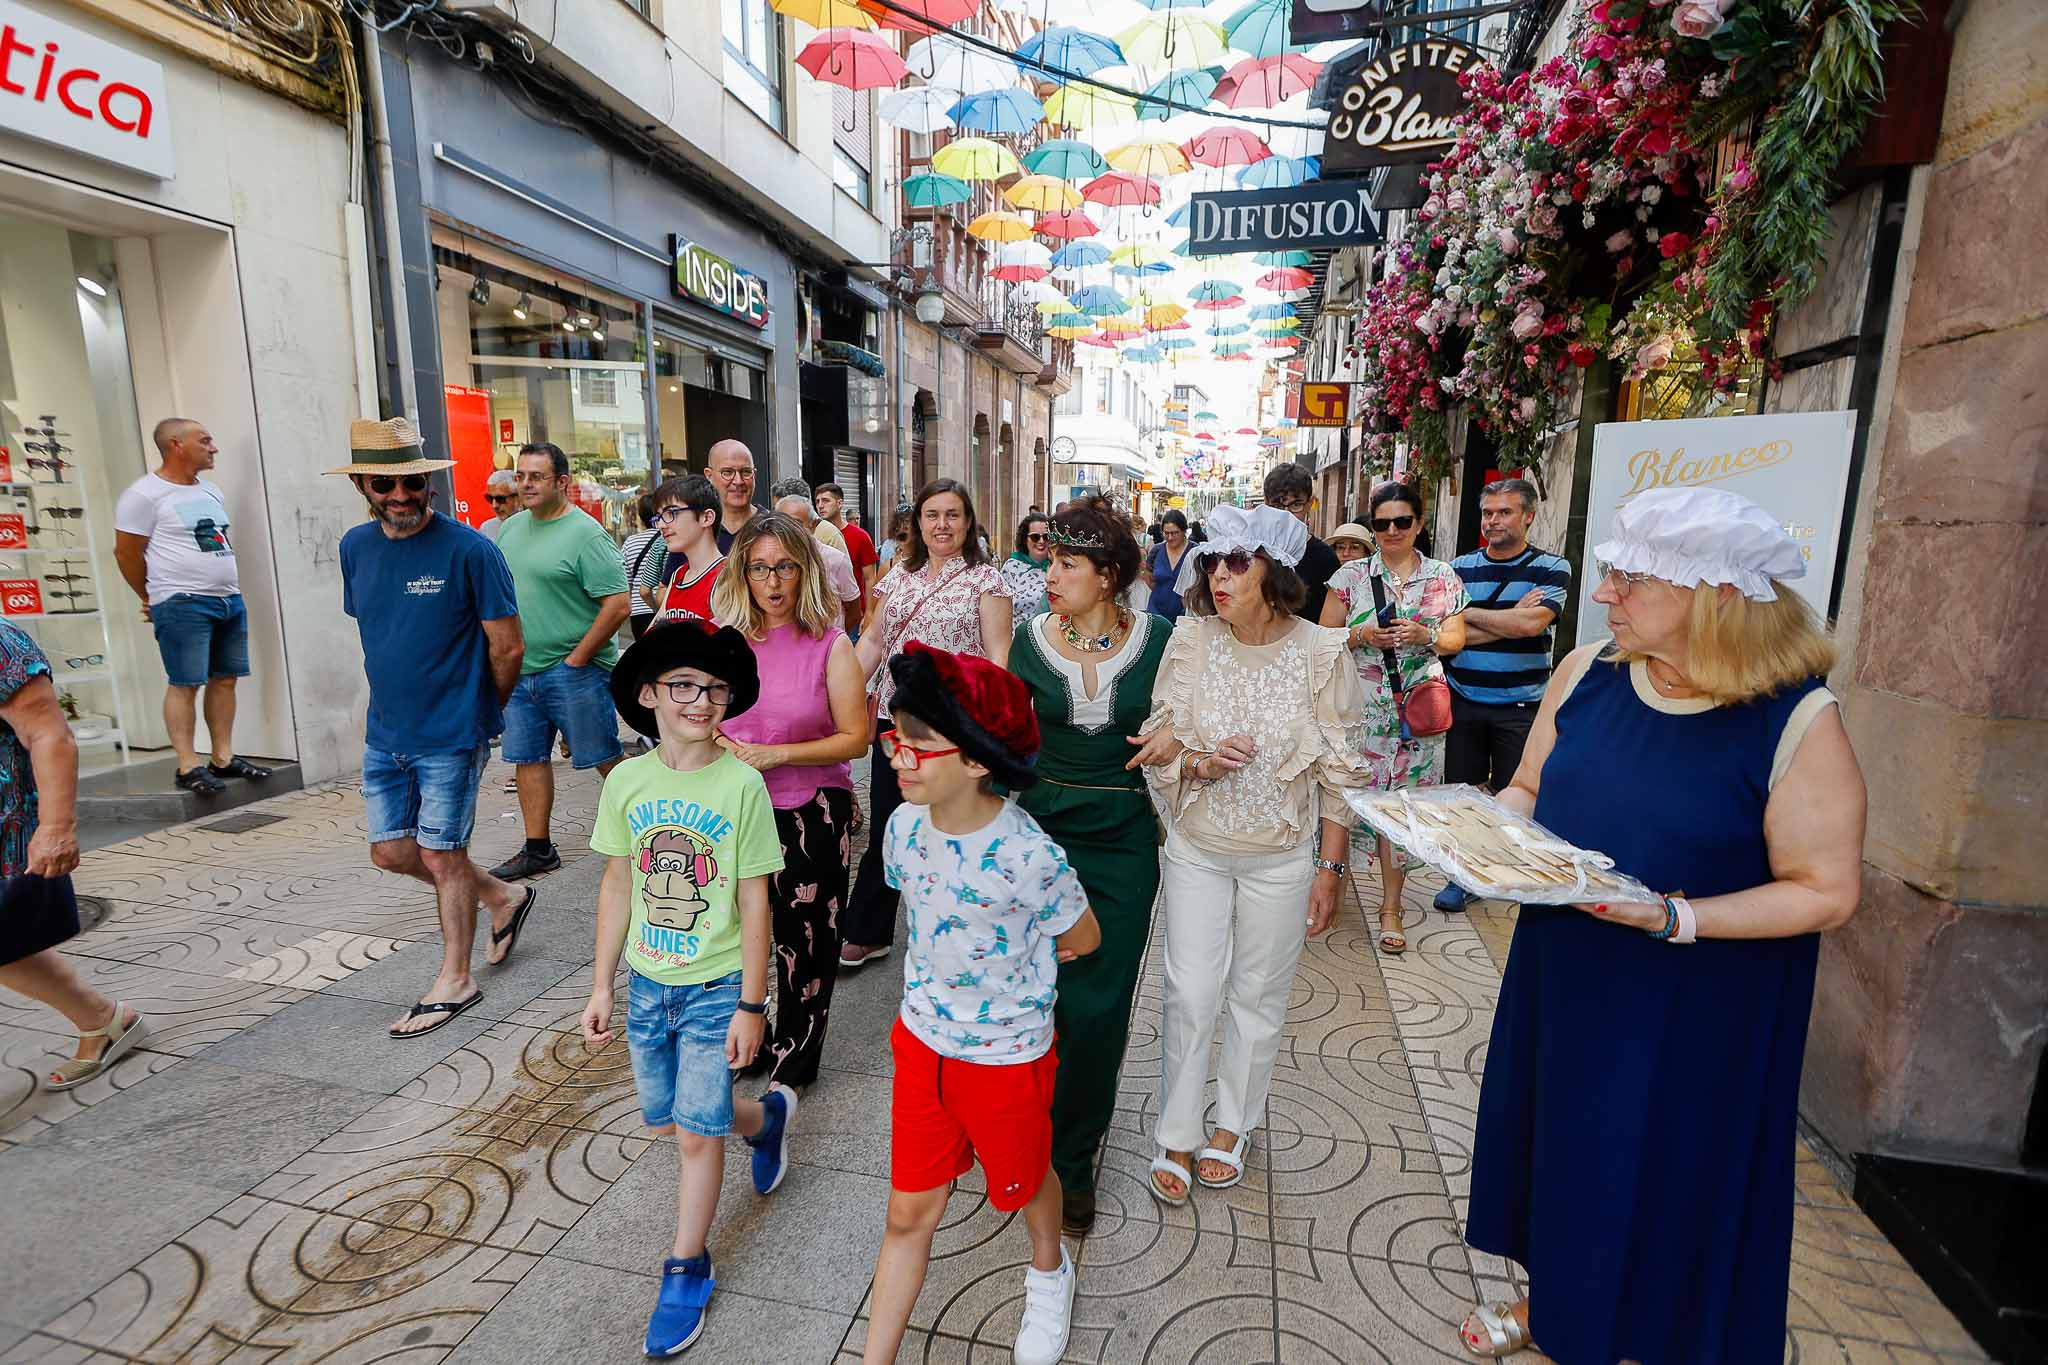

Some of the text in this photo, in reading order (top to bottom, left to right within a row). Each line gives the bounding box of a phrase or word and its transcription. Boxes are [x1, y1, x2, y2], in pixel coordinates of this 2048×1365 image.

[1194, 189, 1384, 243] DIFUSION
[685, 247, 763, 321] INSIDE
[1621, 439, 1793, 498] Blanco
[627, 799, 734, 844] AWESOME
[641, 921, 700, 957] TUNES
